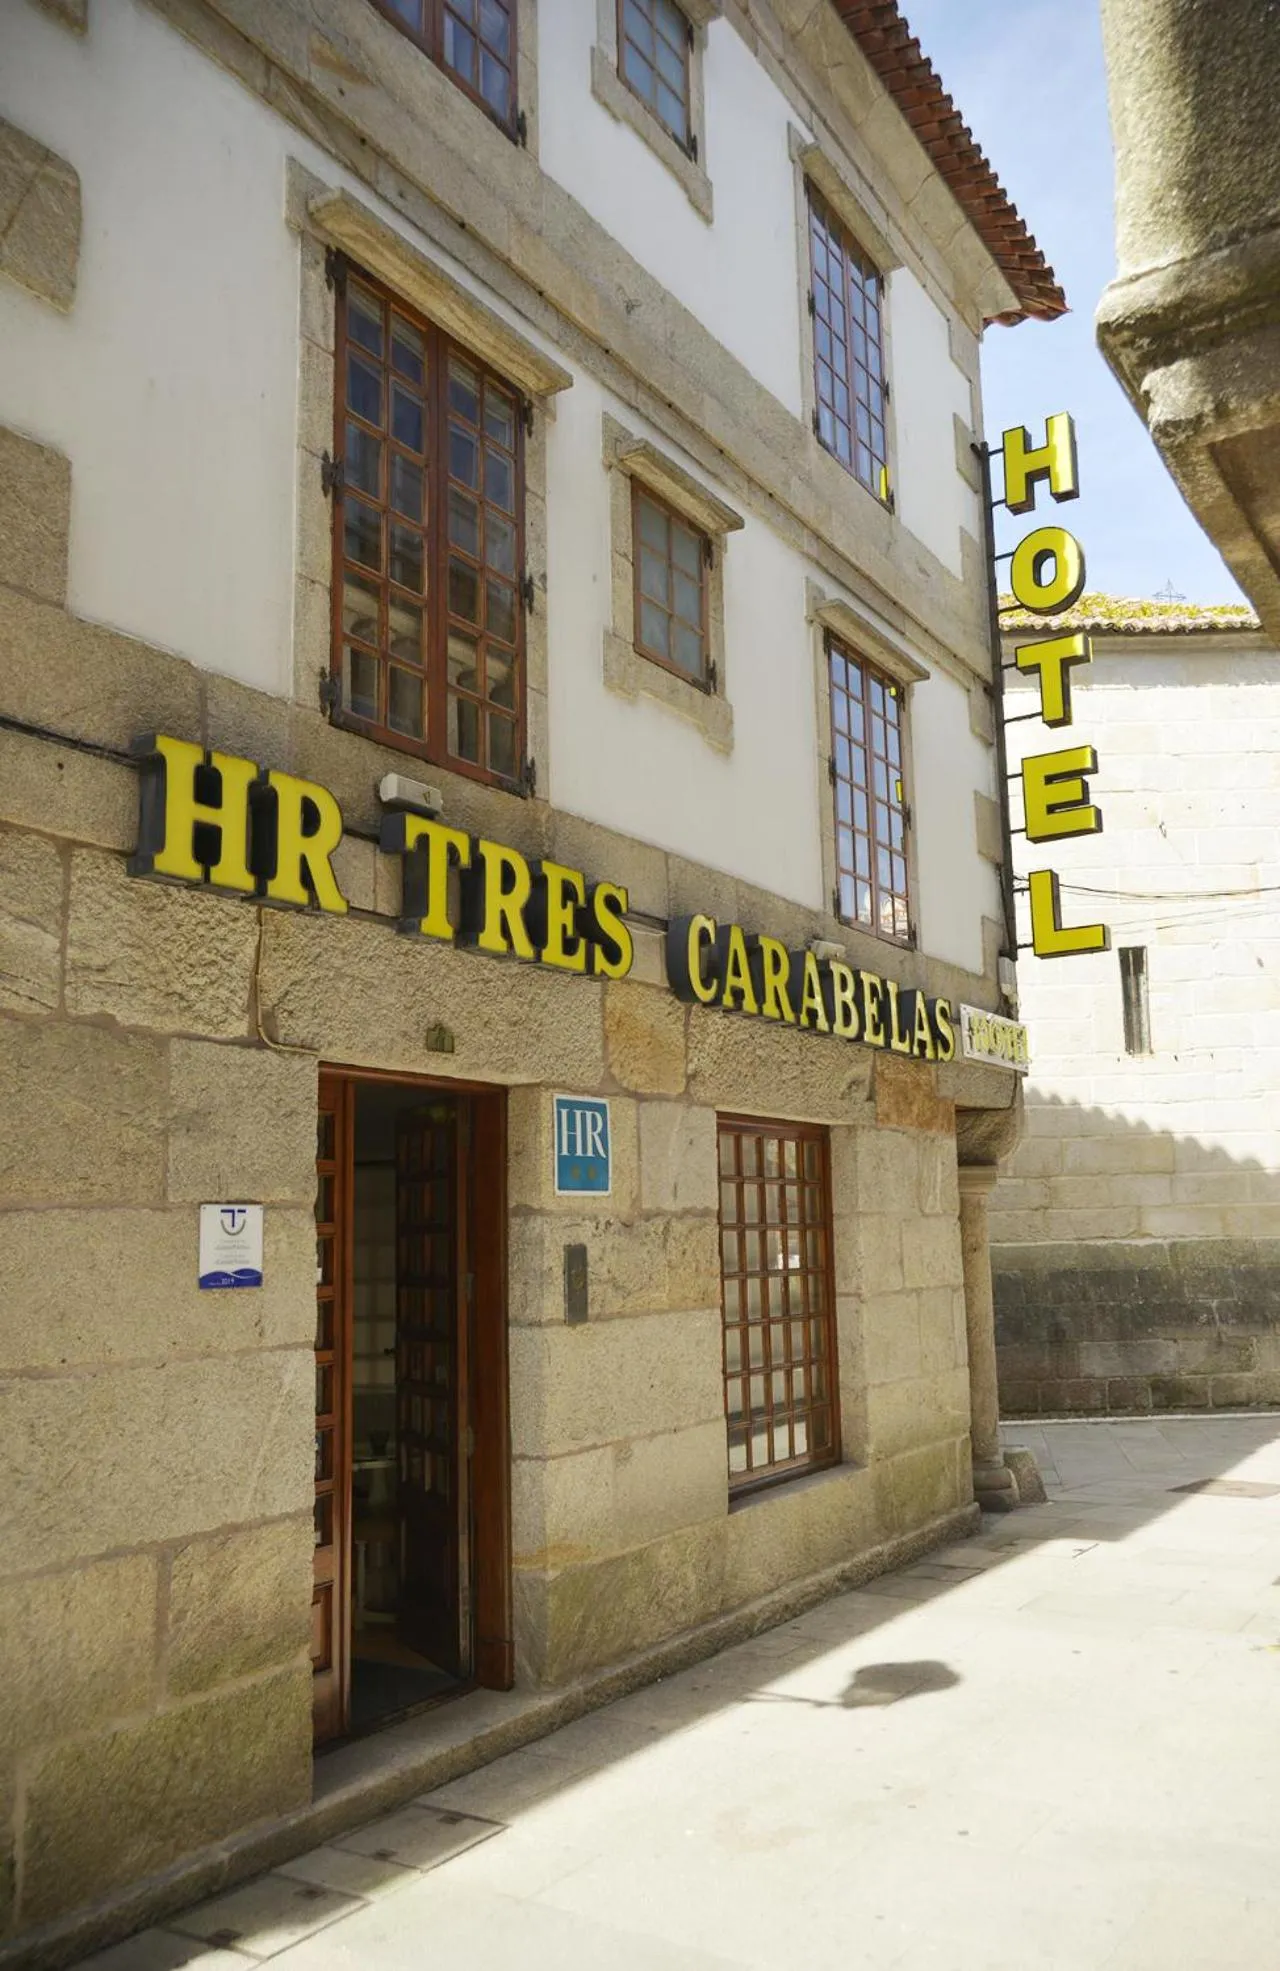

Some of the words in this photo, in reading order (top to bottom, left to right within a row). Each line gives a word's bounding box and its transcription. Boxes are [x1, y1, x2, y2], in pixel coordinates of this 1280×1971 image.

[1002, 411, 1109, 957] HOTEL
[153, 734, 349, 914] HR
[404, 814, 634, 980] TRES
[687, 914, 955, 1062] CARABELAS
[559, 1108, 607, 1158] HR
